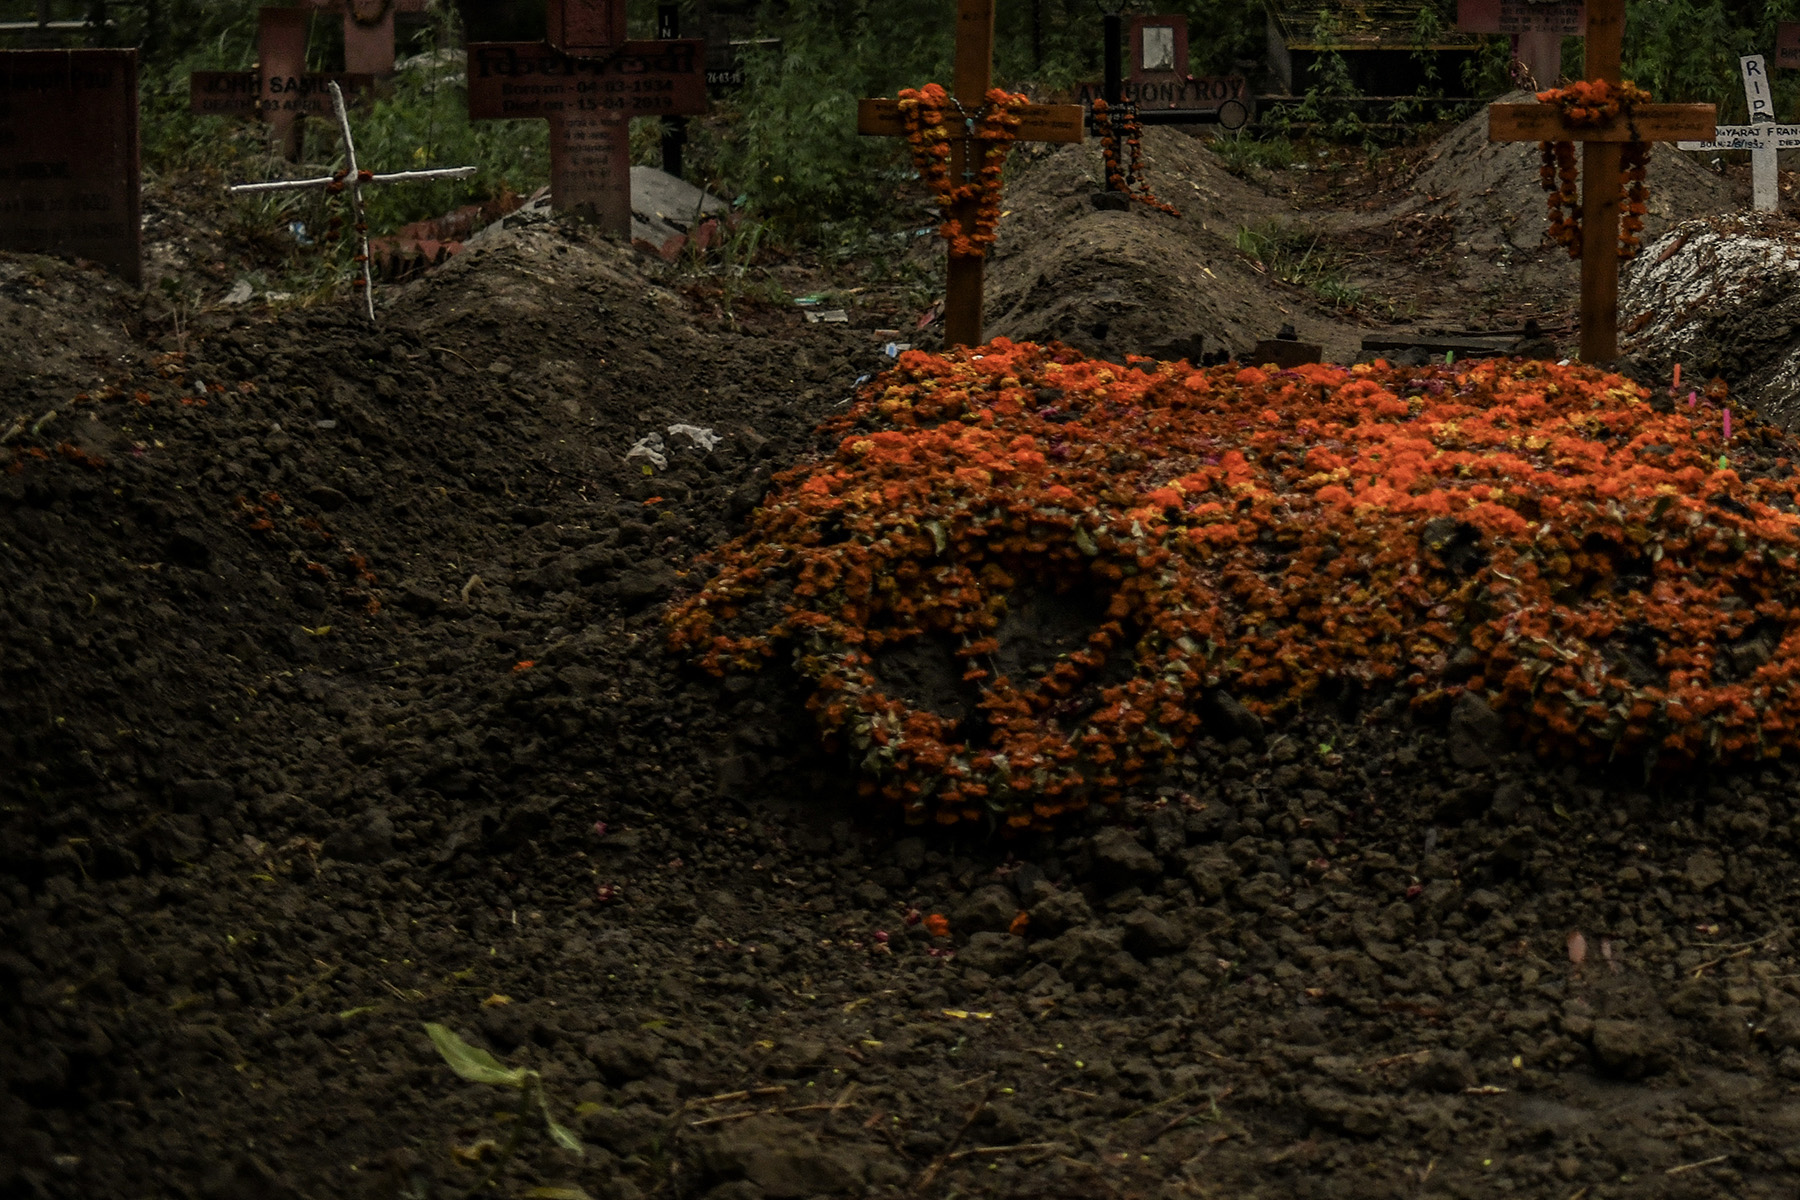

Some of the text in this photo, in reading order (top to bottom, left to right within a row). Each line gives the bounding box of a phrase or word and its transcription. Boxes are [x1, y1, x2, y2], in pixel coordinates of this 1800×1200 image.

[203, 75, 361, 95] JOHN SAMUL
[1078, 78, 1244, 105] ANHONY ROY
